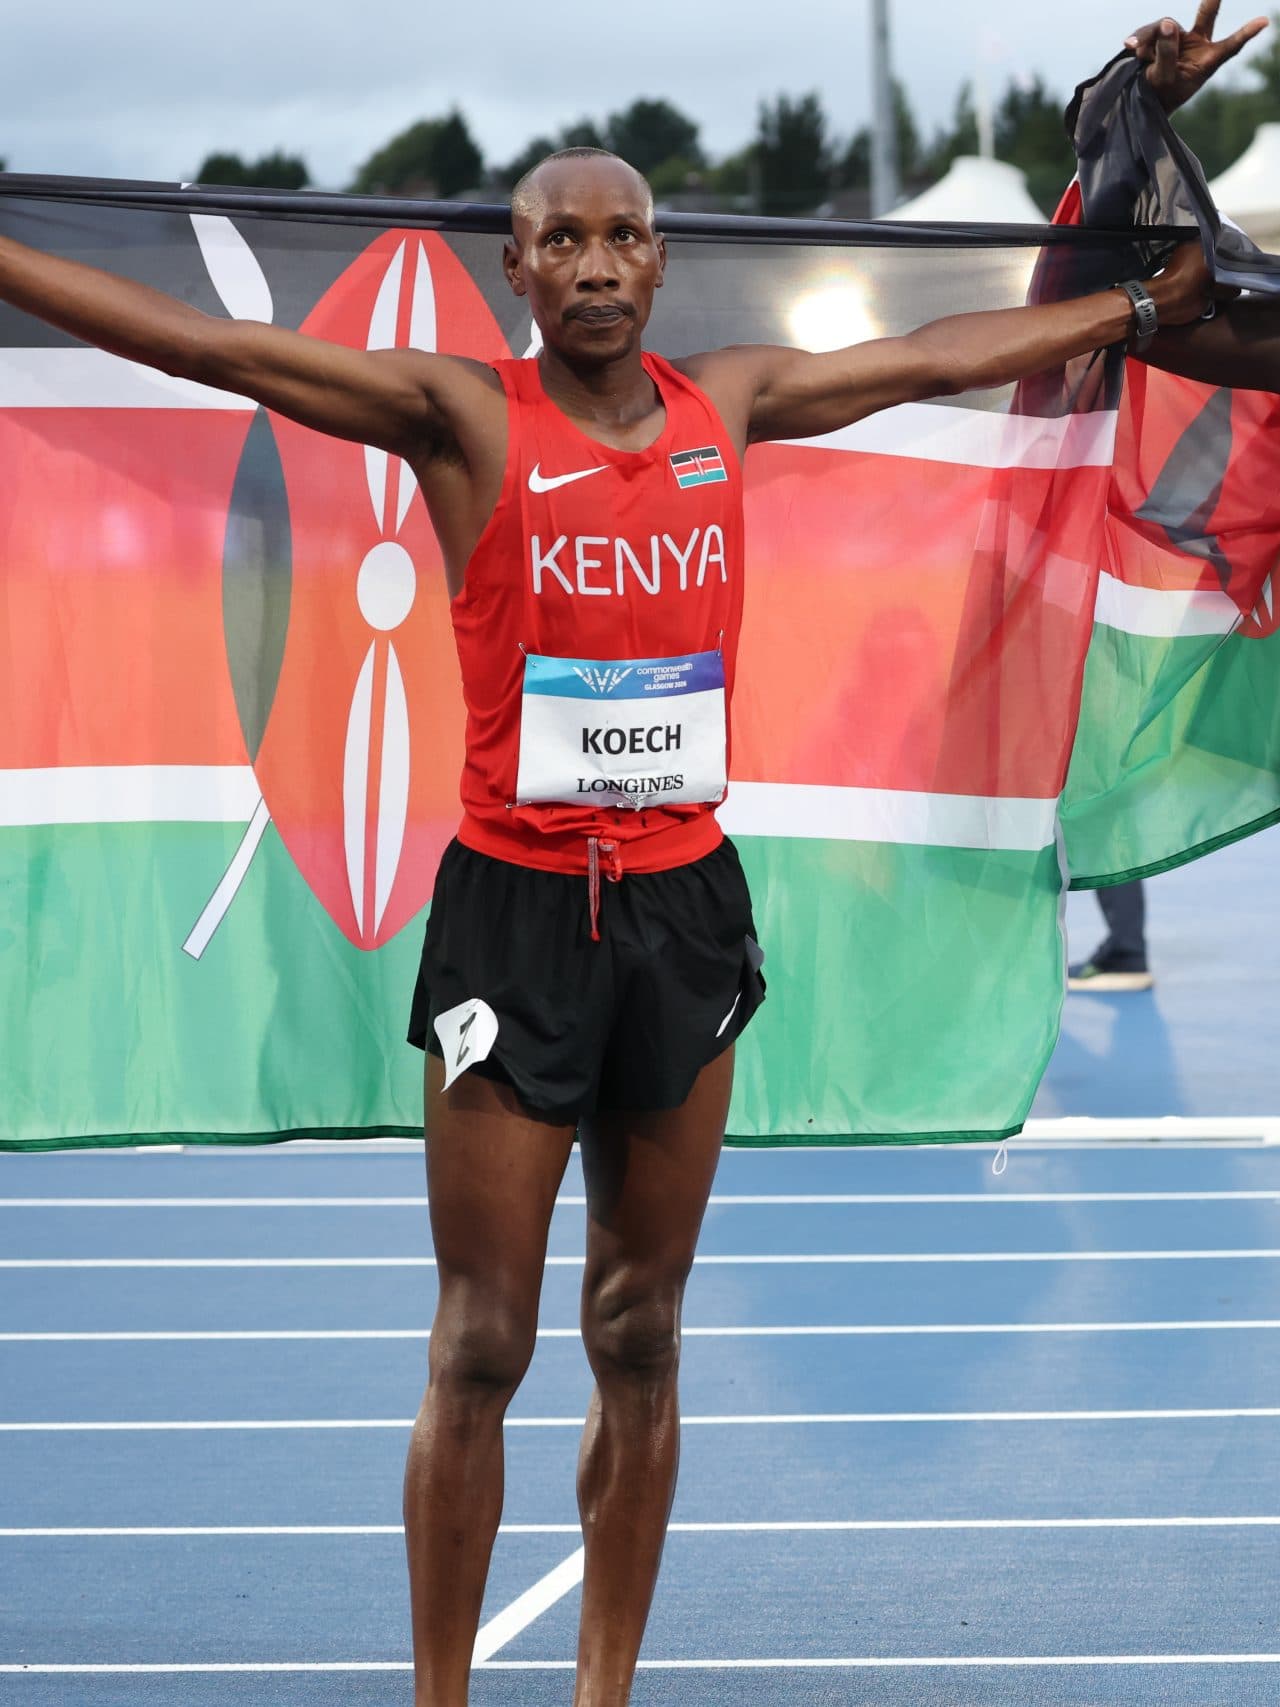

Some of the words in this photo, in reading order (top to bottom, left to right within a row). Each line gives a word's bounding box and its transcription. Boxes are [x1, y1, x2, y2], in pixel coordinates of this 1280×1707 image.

[530, 524, 727, 596] KENYA
[653, 672, 680, 682] games
[582, 723, 681, 755] KOECH
[576, 774, 684, 795] LONGINES
